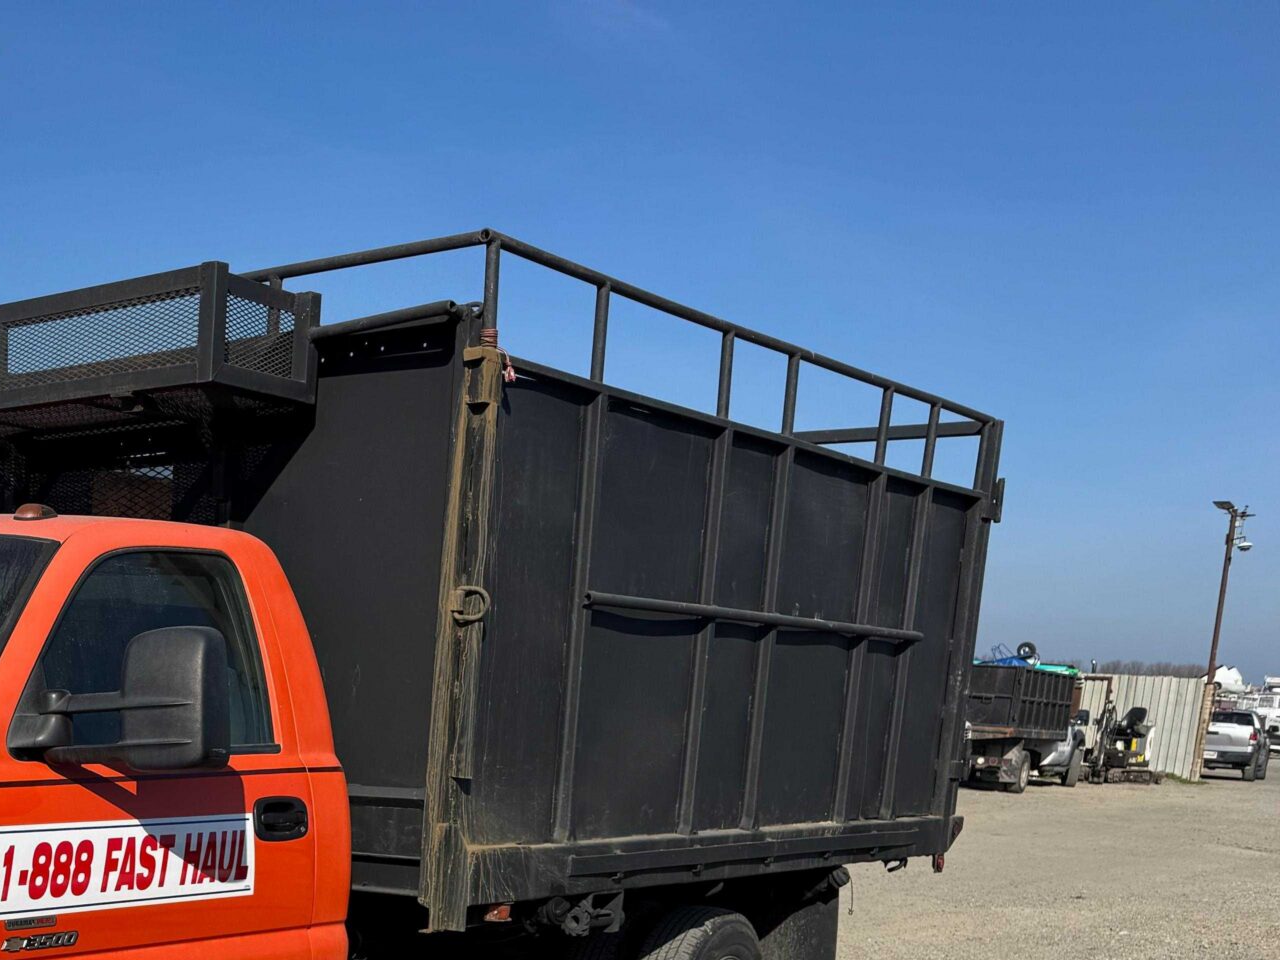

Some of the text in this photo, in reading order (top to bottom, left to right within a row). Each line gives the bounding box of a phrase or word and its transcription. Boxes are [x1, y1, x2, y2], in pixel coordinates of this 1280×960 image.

[1, 830, 249, 902] 1-888 FAST HAUL
